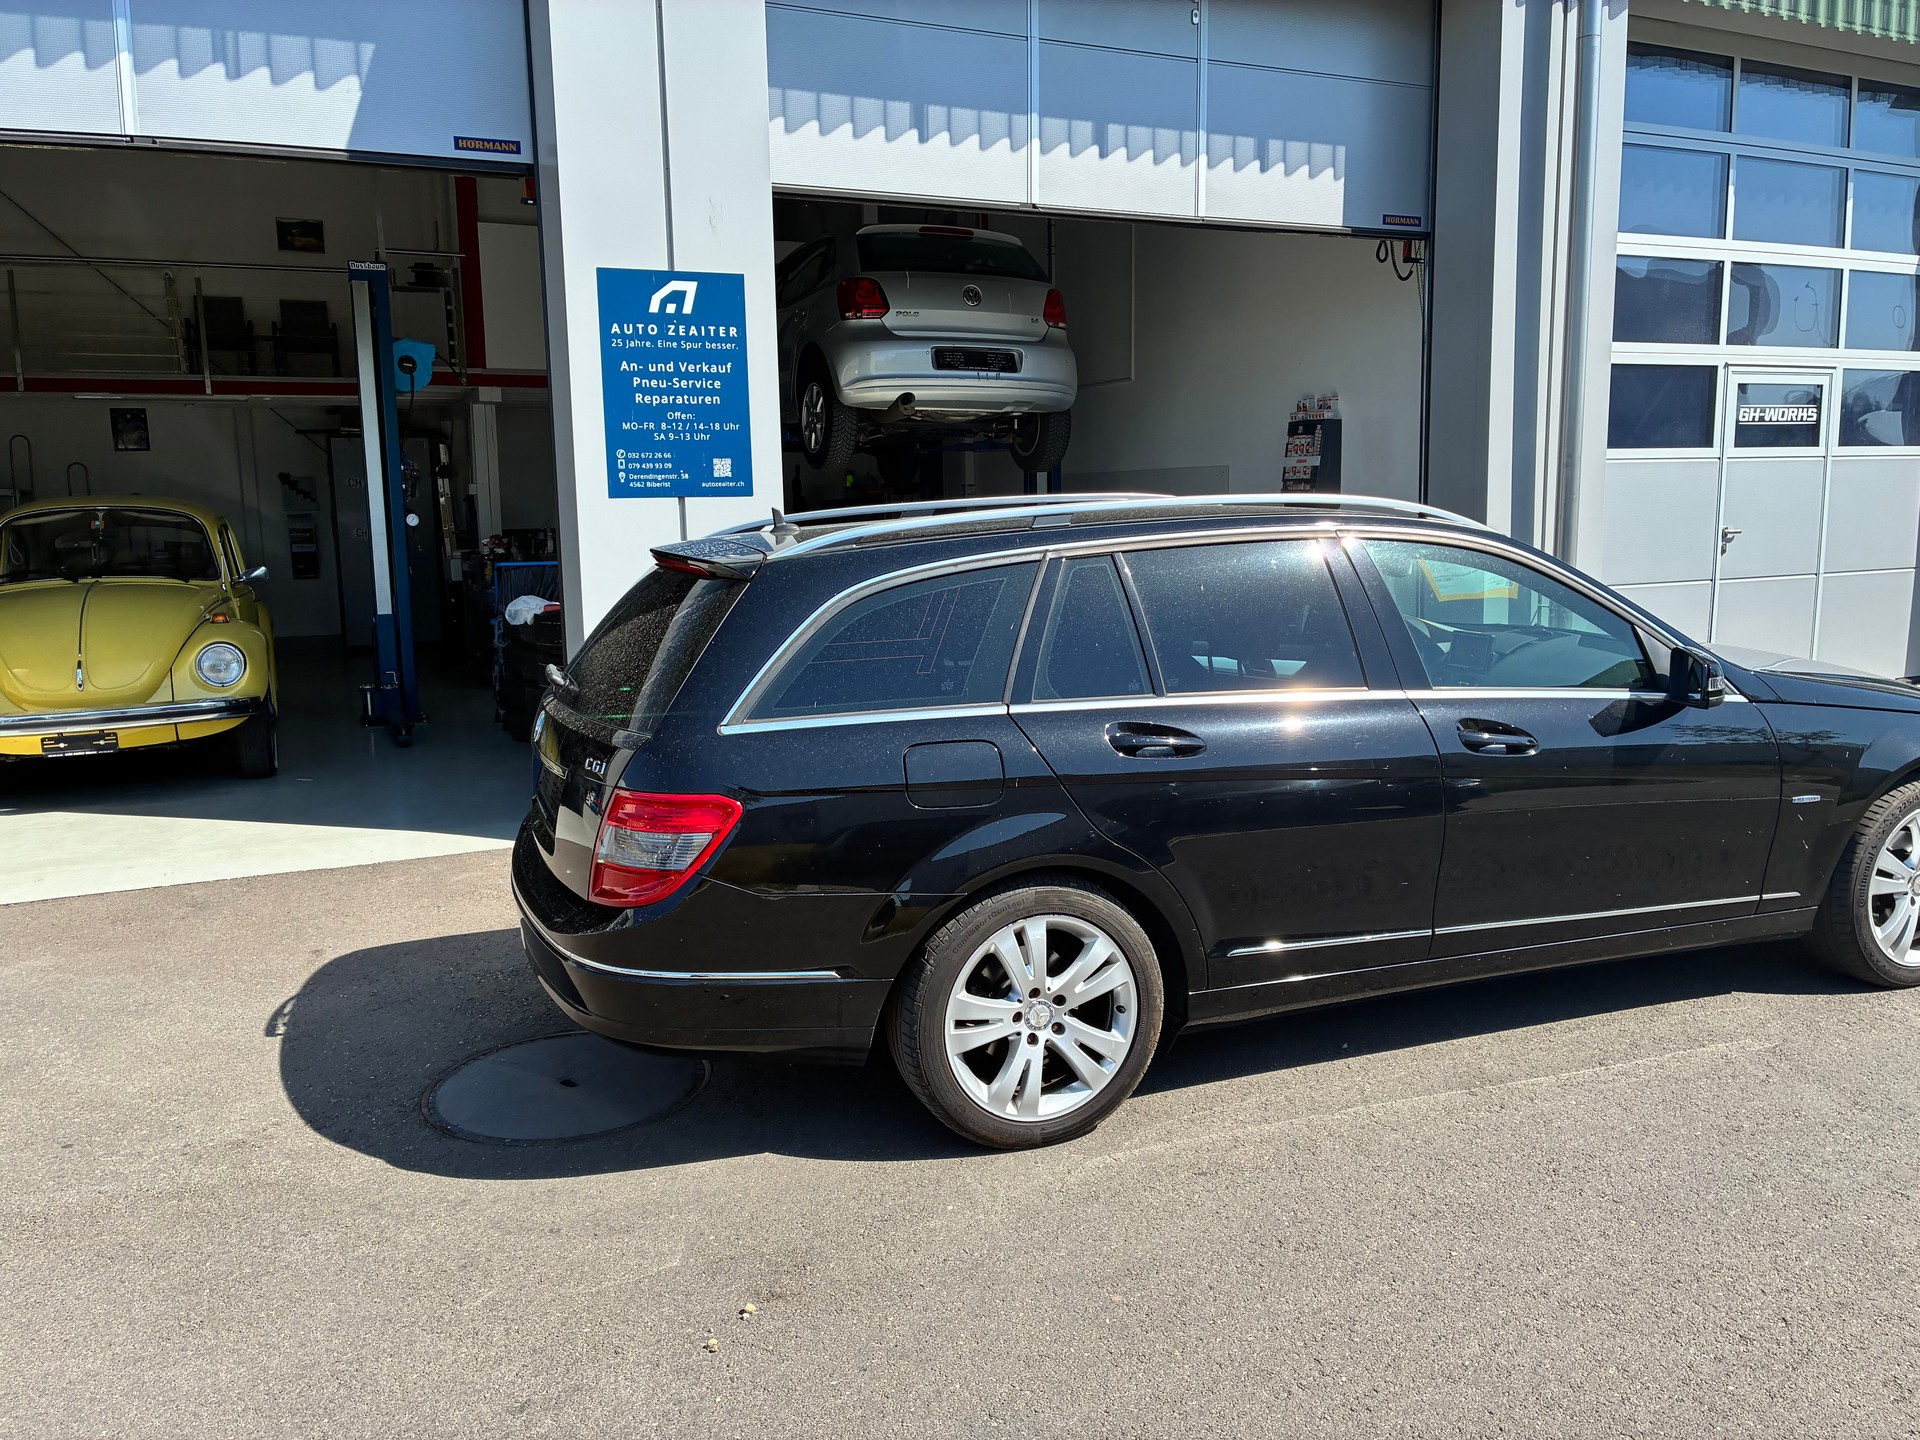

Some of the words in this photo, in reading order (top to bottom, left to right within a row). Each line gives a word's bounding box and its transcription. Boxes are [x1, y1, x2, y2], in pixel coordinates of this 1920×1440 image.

[458, 138, 517, 152] HÖRMANN
[895, 310, 921, 318] POLO
[610, 322, 658, 335] AUTO
[667, 324, 738, 338] ZEAITER
[611, 338, 623, 347] 25
[625, 339, 654, 349] Jahre.
[657, 339, 678, 348] Eine
[680, 340, 703, 351] Spur
[705, 341, 739, 350] besser.
[620, 360, 644, 372] An-
[648, 361, 674, 372] und
[678, 361, 732, 373] Verkauf
[633, 376, 721, 389] Pneu-Service
[635, 393, 720, 407] Reparaturen
[667, 411, 696, 420] Offen:
[723, 422, 740, 431] Uhr
[653, 432, 666, 441] SA
[693, 432, 711, 441] Uhr
[628, 473, 680, 481] Derendingenstr.
[584, 757, 608, 775] CGI
